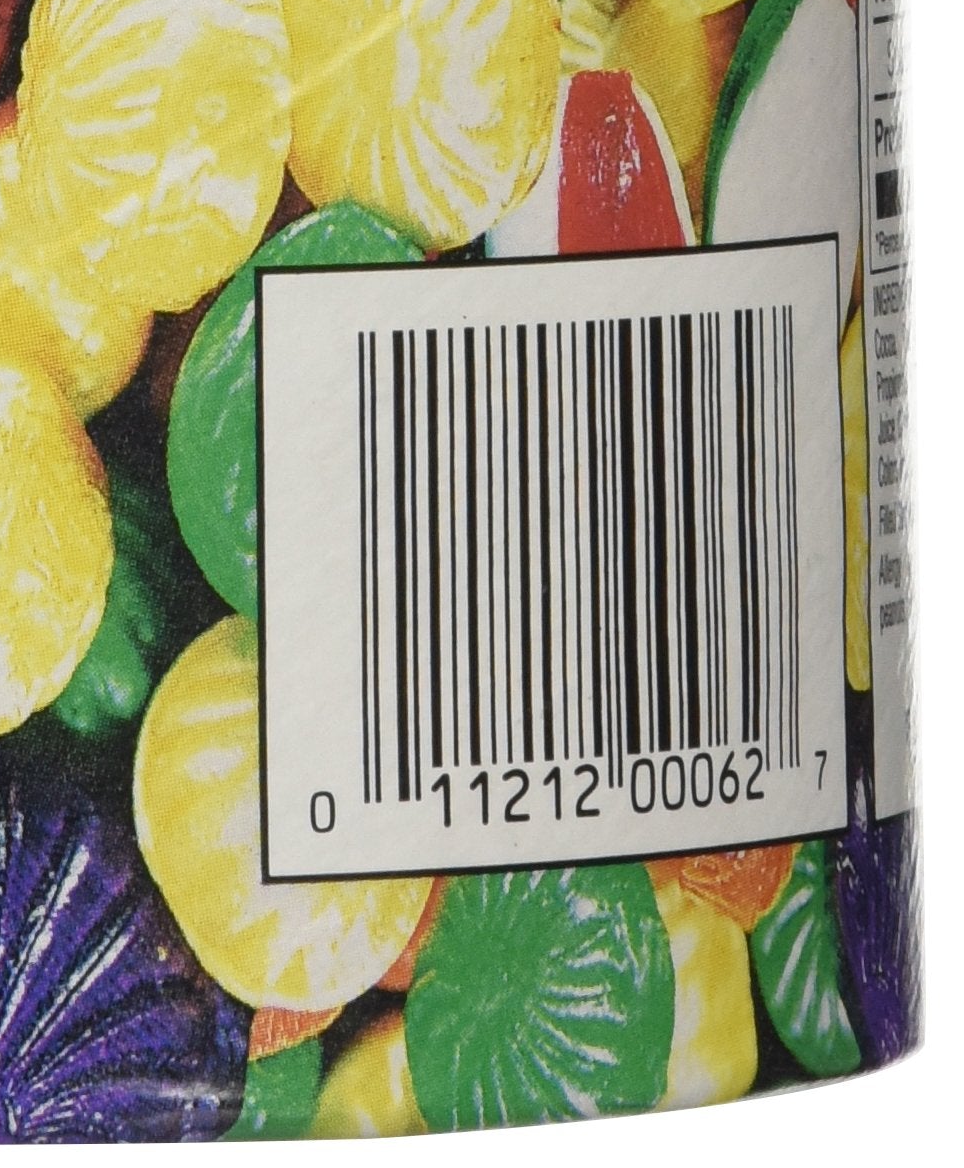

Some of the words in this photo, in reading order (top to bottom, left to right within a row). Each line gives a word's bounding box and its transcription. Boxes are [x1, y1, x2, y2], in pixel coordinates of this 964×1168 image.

[309, 790, 336, 833] 0
[430, 763, 601, 828] 11212
[629, 746, 766, 814] 00062
[813, 749, 828, 791] 7
